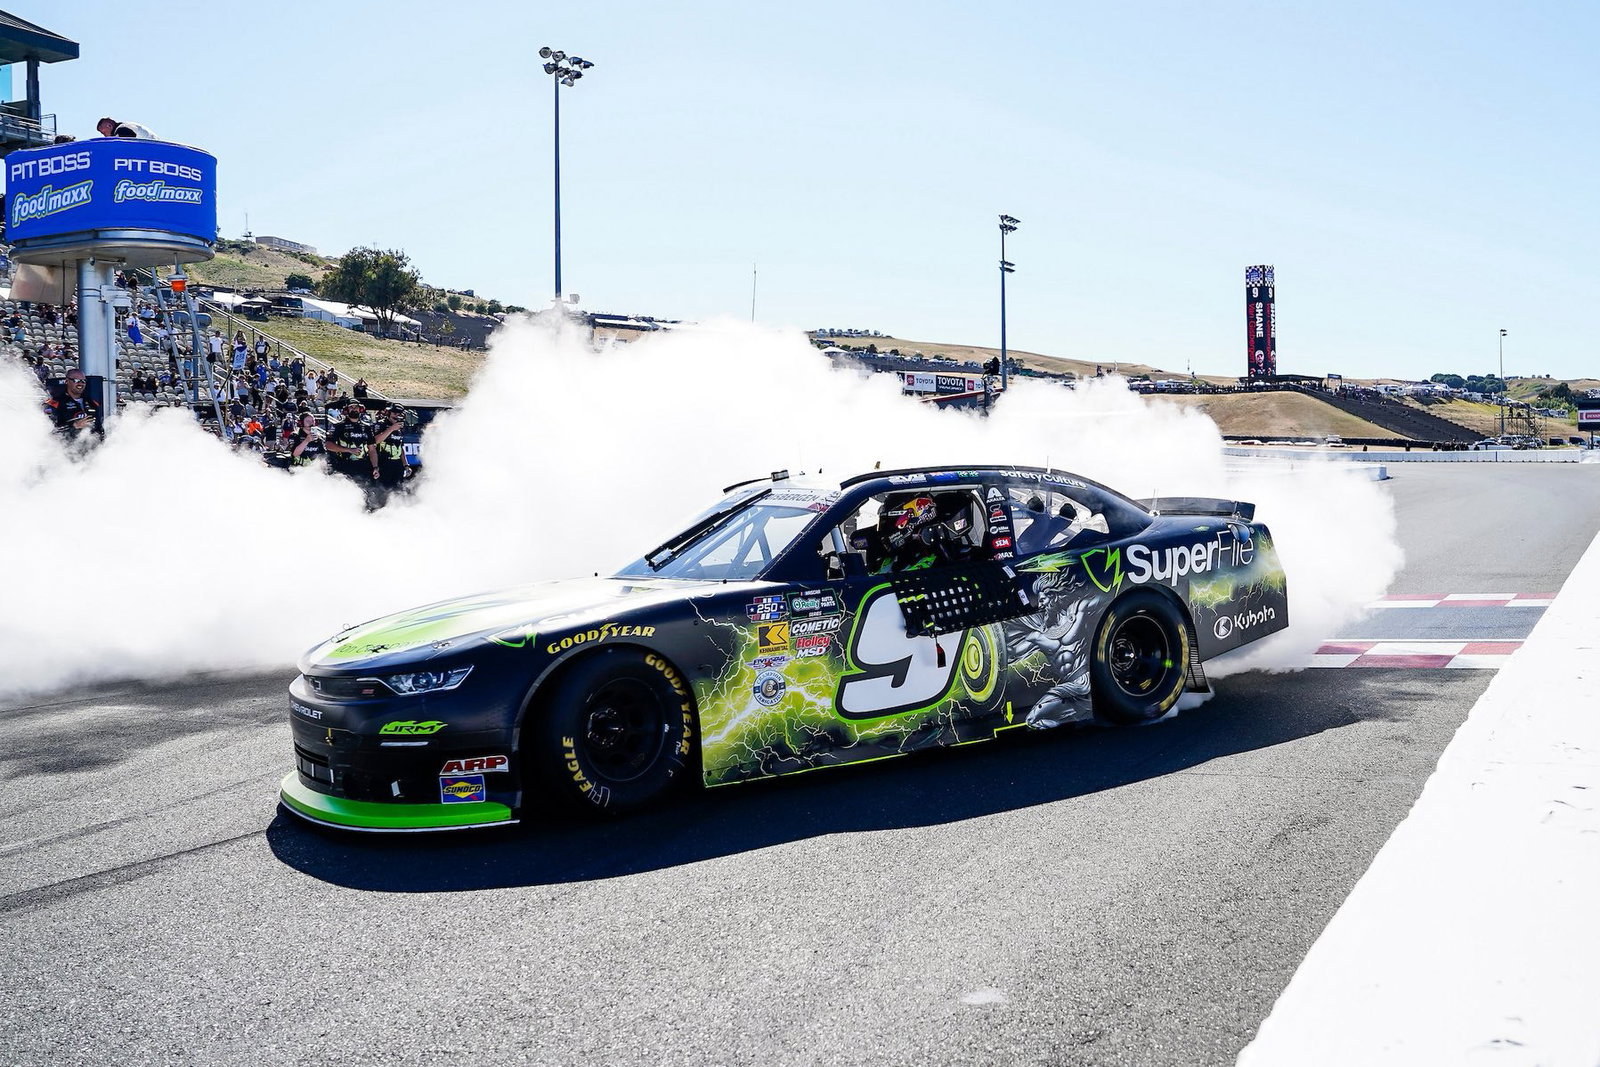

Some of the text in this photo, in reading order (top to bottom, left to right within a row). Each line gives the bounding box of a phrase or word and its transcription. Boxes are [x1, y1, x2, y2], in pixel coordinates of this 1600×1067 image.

[11, 152, 91, 182] PIT BOSS
[114, 159, 202, 182] PIT BOSS
[1252, 287, 1259, 298] 9
[1255, 302, 1264, 338] SHANE
[937, 376, 964, 387] TOYOTA
[999, 470, 1087, 489] SafetyCulture
[756, 602, 778, 614] 250
[791, 618, 839, 634] COMETIC
[1234, 605, 1276, 630] Kubota
[795, 635, 831, 649] Holley
[796, 646, 827, 659] MSD
[838, 586, 970, 719] 9
[383, 725, 435, 734] JRM
[442, 756, 507, 773] ARP
[562, 736, 593, 793] EAGLE
